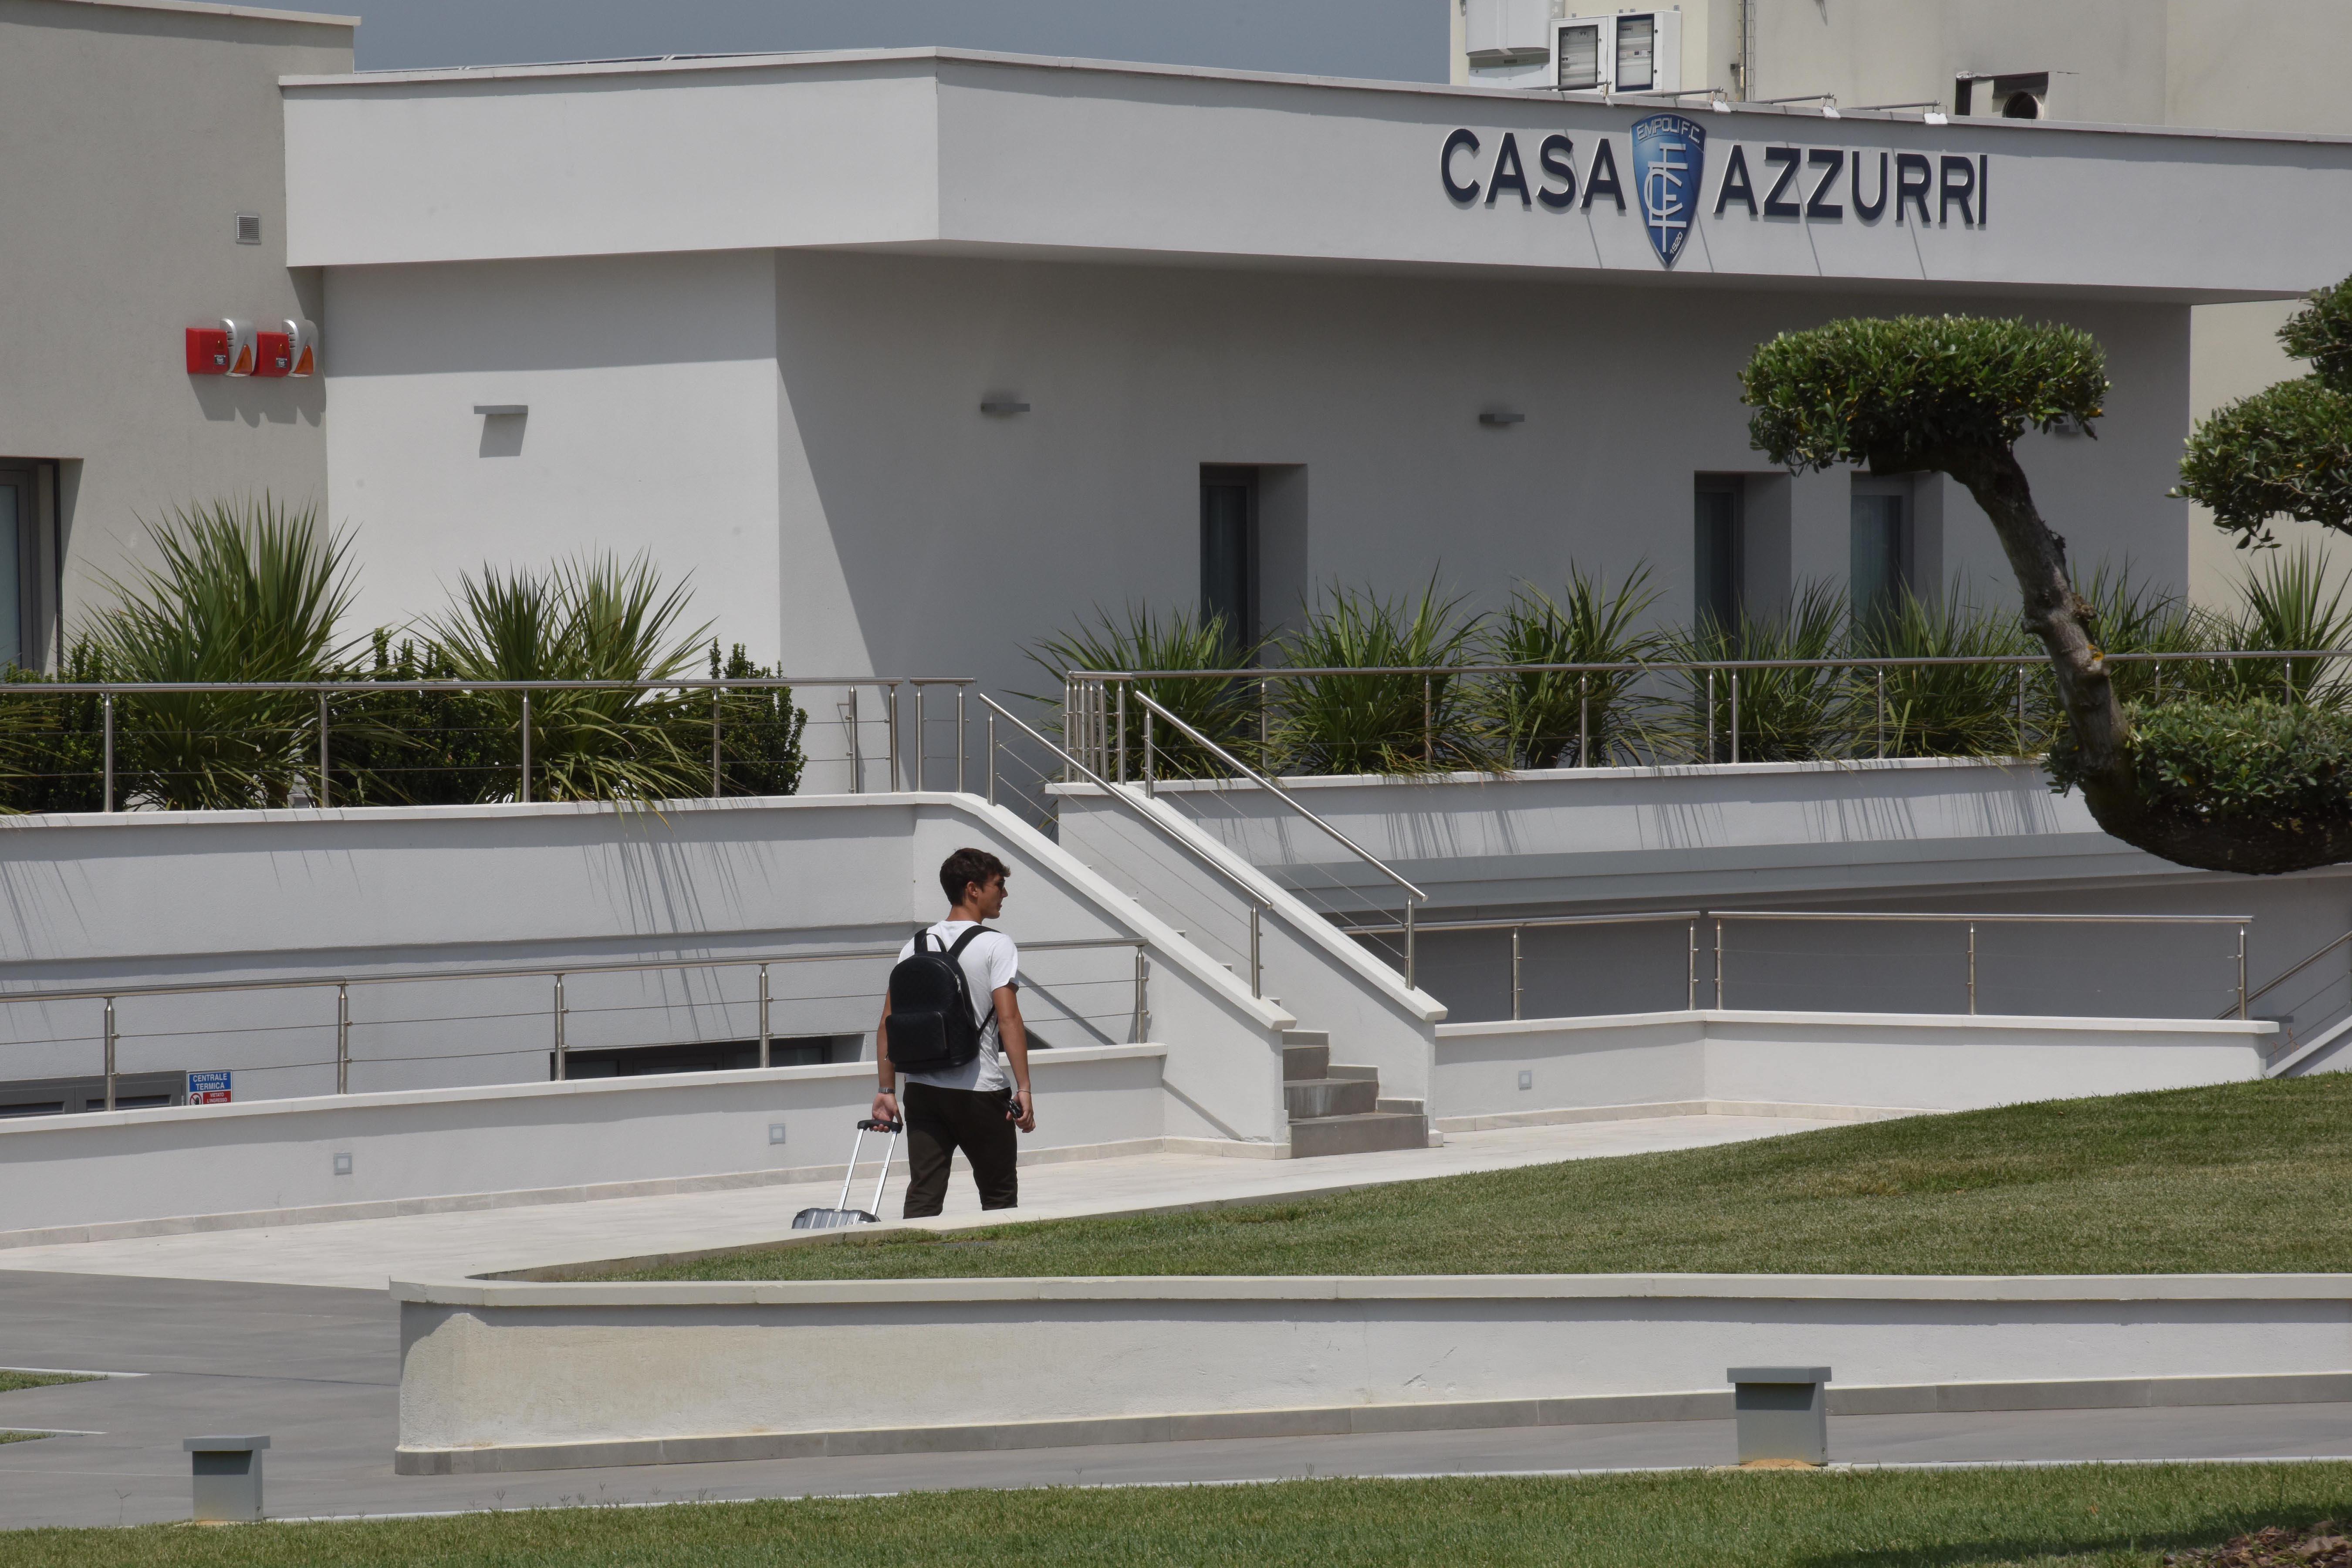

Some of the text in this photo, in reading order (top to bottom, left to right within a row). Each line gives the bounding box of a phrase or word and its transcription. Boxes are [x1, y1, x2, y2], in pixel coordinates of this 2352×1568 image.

[1637, 117, 1680, 141] EMPOLI
[1440, 128, 1987, 225] CASA AZZURRI
[1669, 231, 1683, 255] 1920
[193, 1073, 227, 1082] CENTRALE
[196, 1082, 225, 1090] TERMICA
